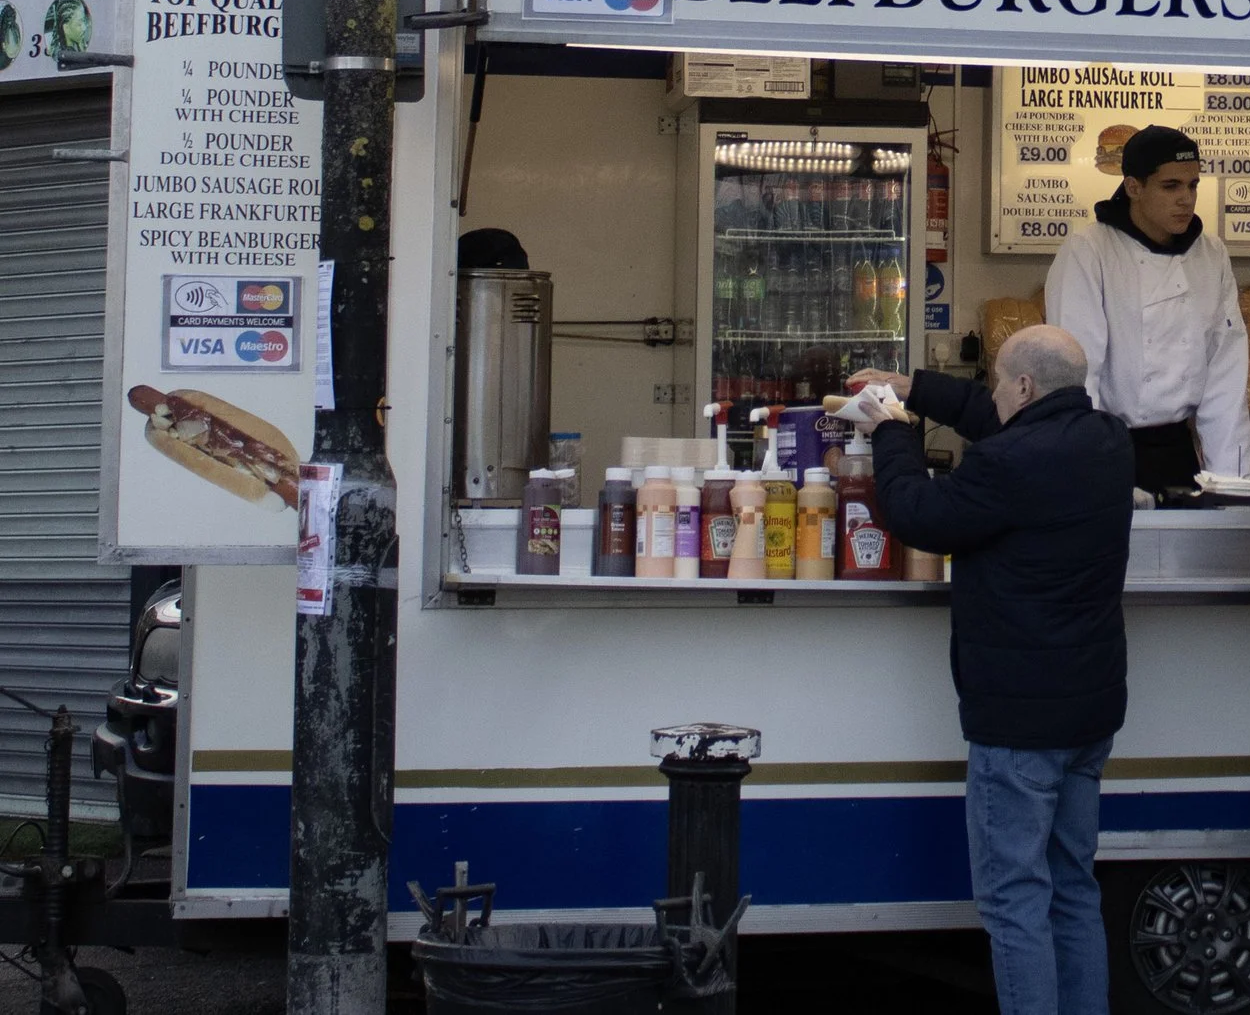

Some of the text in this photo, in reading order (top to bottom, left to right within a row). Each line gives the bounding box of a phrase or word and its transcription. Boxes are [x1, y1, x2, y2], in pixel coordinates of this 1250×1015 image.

[146, 11, 282, 43] BEEFBURG
[208, 61, 284, 80] POUNDE
[1021, 67, 1070, 88] JUMBO
[1074, 67, 1137, 86] SAUSAGE
[1140, 72, 1175, 87] ROLL
[206, 89, 295, 108] POUNDER
[1021, 89, 1064, 108] LARGE
[1068, 90, 1163, 110] FRANKFURTER
[175, 108, 300, 124] WITH CHEESE
[1029, 112, 1075, 121] POUNDER
[1005, 123, 1085, 132] CHEESE BURGER
[205, 133, 293, 152] POUNDER
[1014, 134, 1076, 143] WITH BACON
[160, 151, 311, 169] DOUBLE CHEESE
[1020, 147, 1067, 162] £9.00
[133, 175, 322, 196] JUMBO SAUSAGE ROL
[1025, 179, 1069, 189] JUMBO
[1017, 193, 1074, 204] SAUSAGE
[133, 201, 322, 222] LARGE FRANKFURTE
[1003, 207, 1089, 217] DOUBLE CHEESE
[1021, 222, 1068, 237] £8.00
[139, 229, 320, 250] SPICY BEANBURGER
[171, 251, 296, 266] WITH CHEESE
[242, 293, 284, 302] MasterCard
[178, 317, 285, 326] CARD PAYMENTS WELCOME
[179, 338, 283, 355] VISA Maestro
[765, 546, 791, 558] ustard
